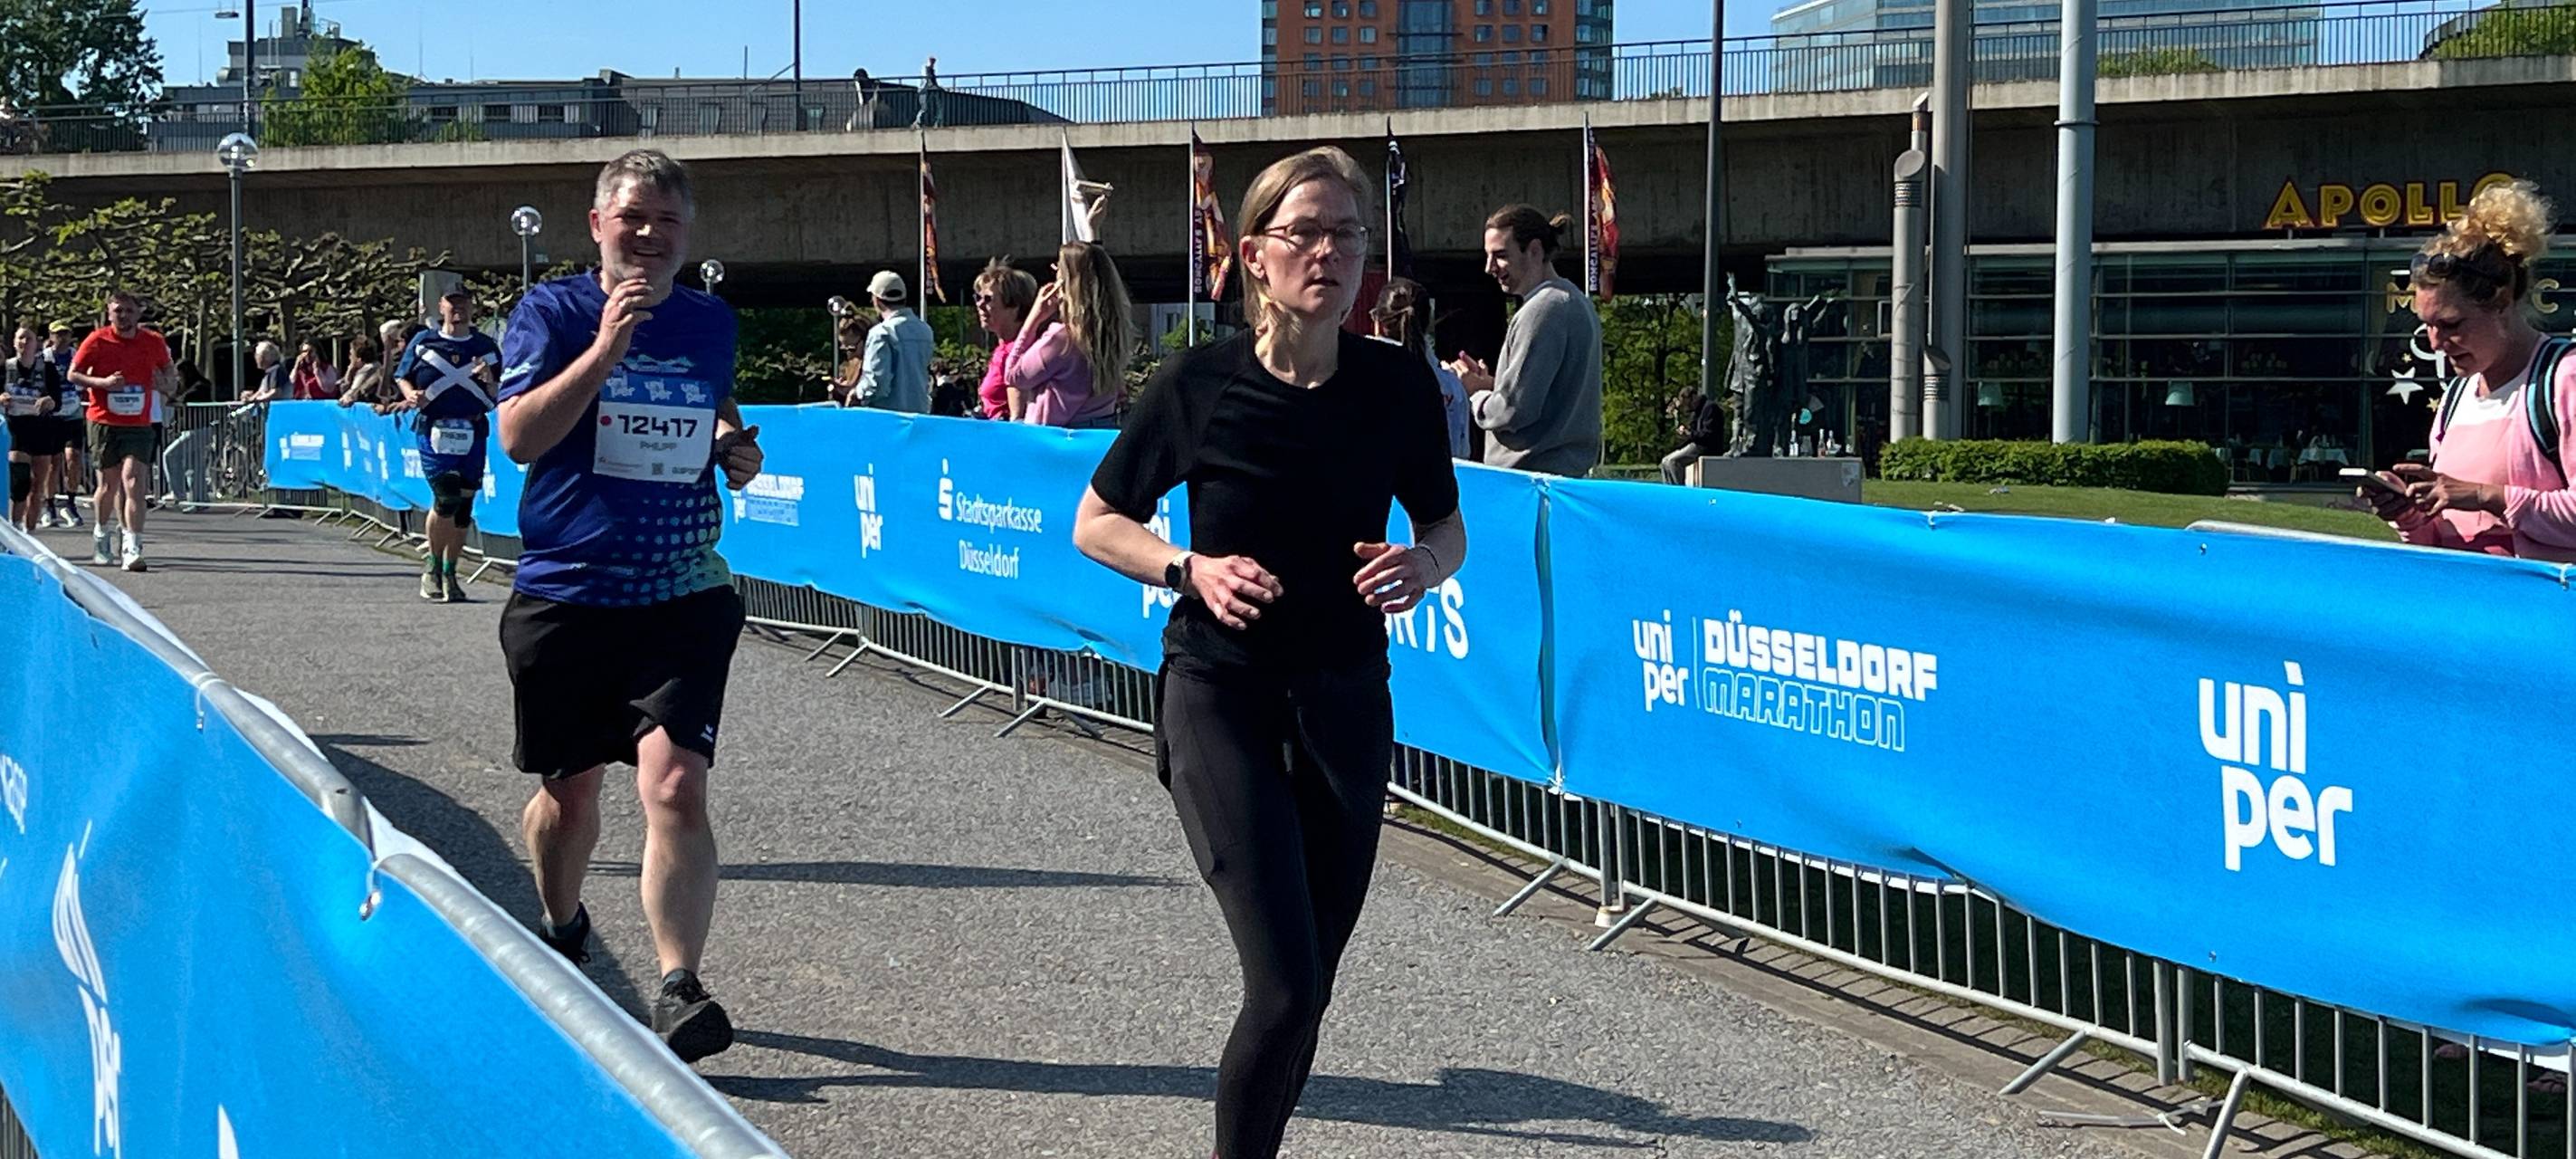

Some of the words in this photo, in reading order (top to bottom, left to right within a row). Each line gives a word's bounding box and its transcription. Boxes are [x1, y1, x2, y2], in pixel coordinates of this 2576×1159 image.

[617, 414, 698, 438] 12417
[854, 463, 876, 513] uni
[956, 492, 1043, 534] Stadtsparkasse
[860, 512, 883, 560] per
[959, 539, 1020, 580] Düsseldorf
[1632, 609, 1674, 664] uni
[1703, 609, 1938, 702] DÜSSELDORF
[1643, 660, 1689, 713] per
[1702, 666, 1905, 752] MARATHON
[2198, 660, 2307, 775] uni
[2220, 765, 2353, 872] per
